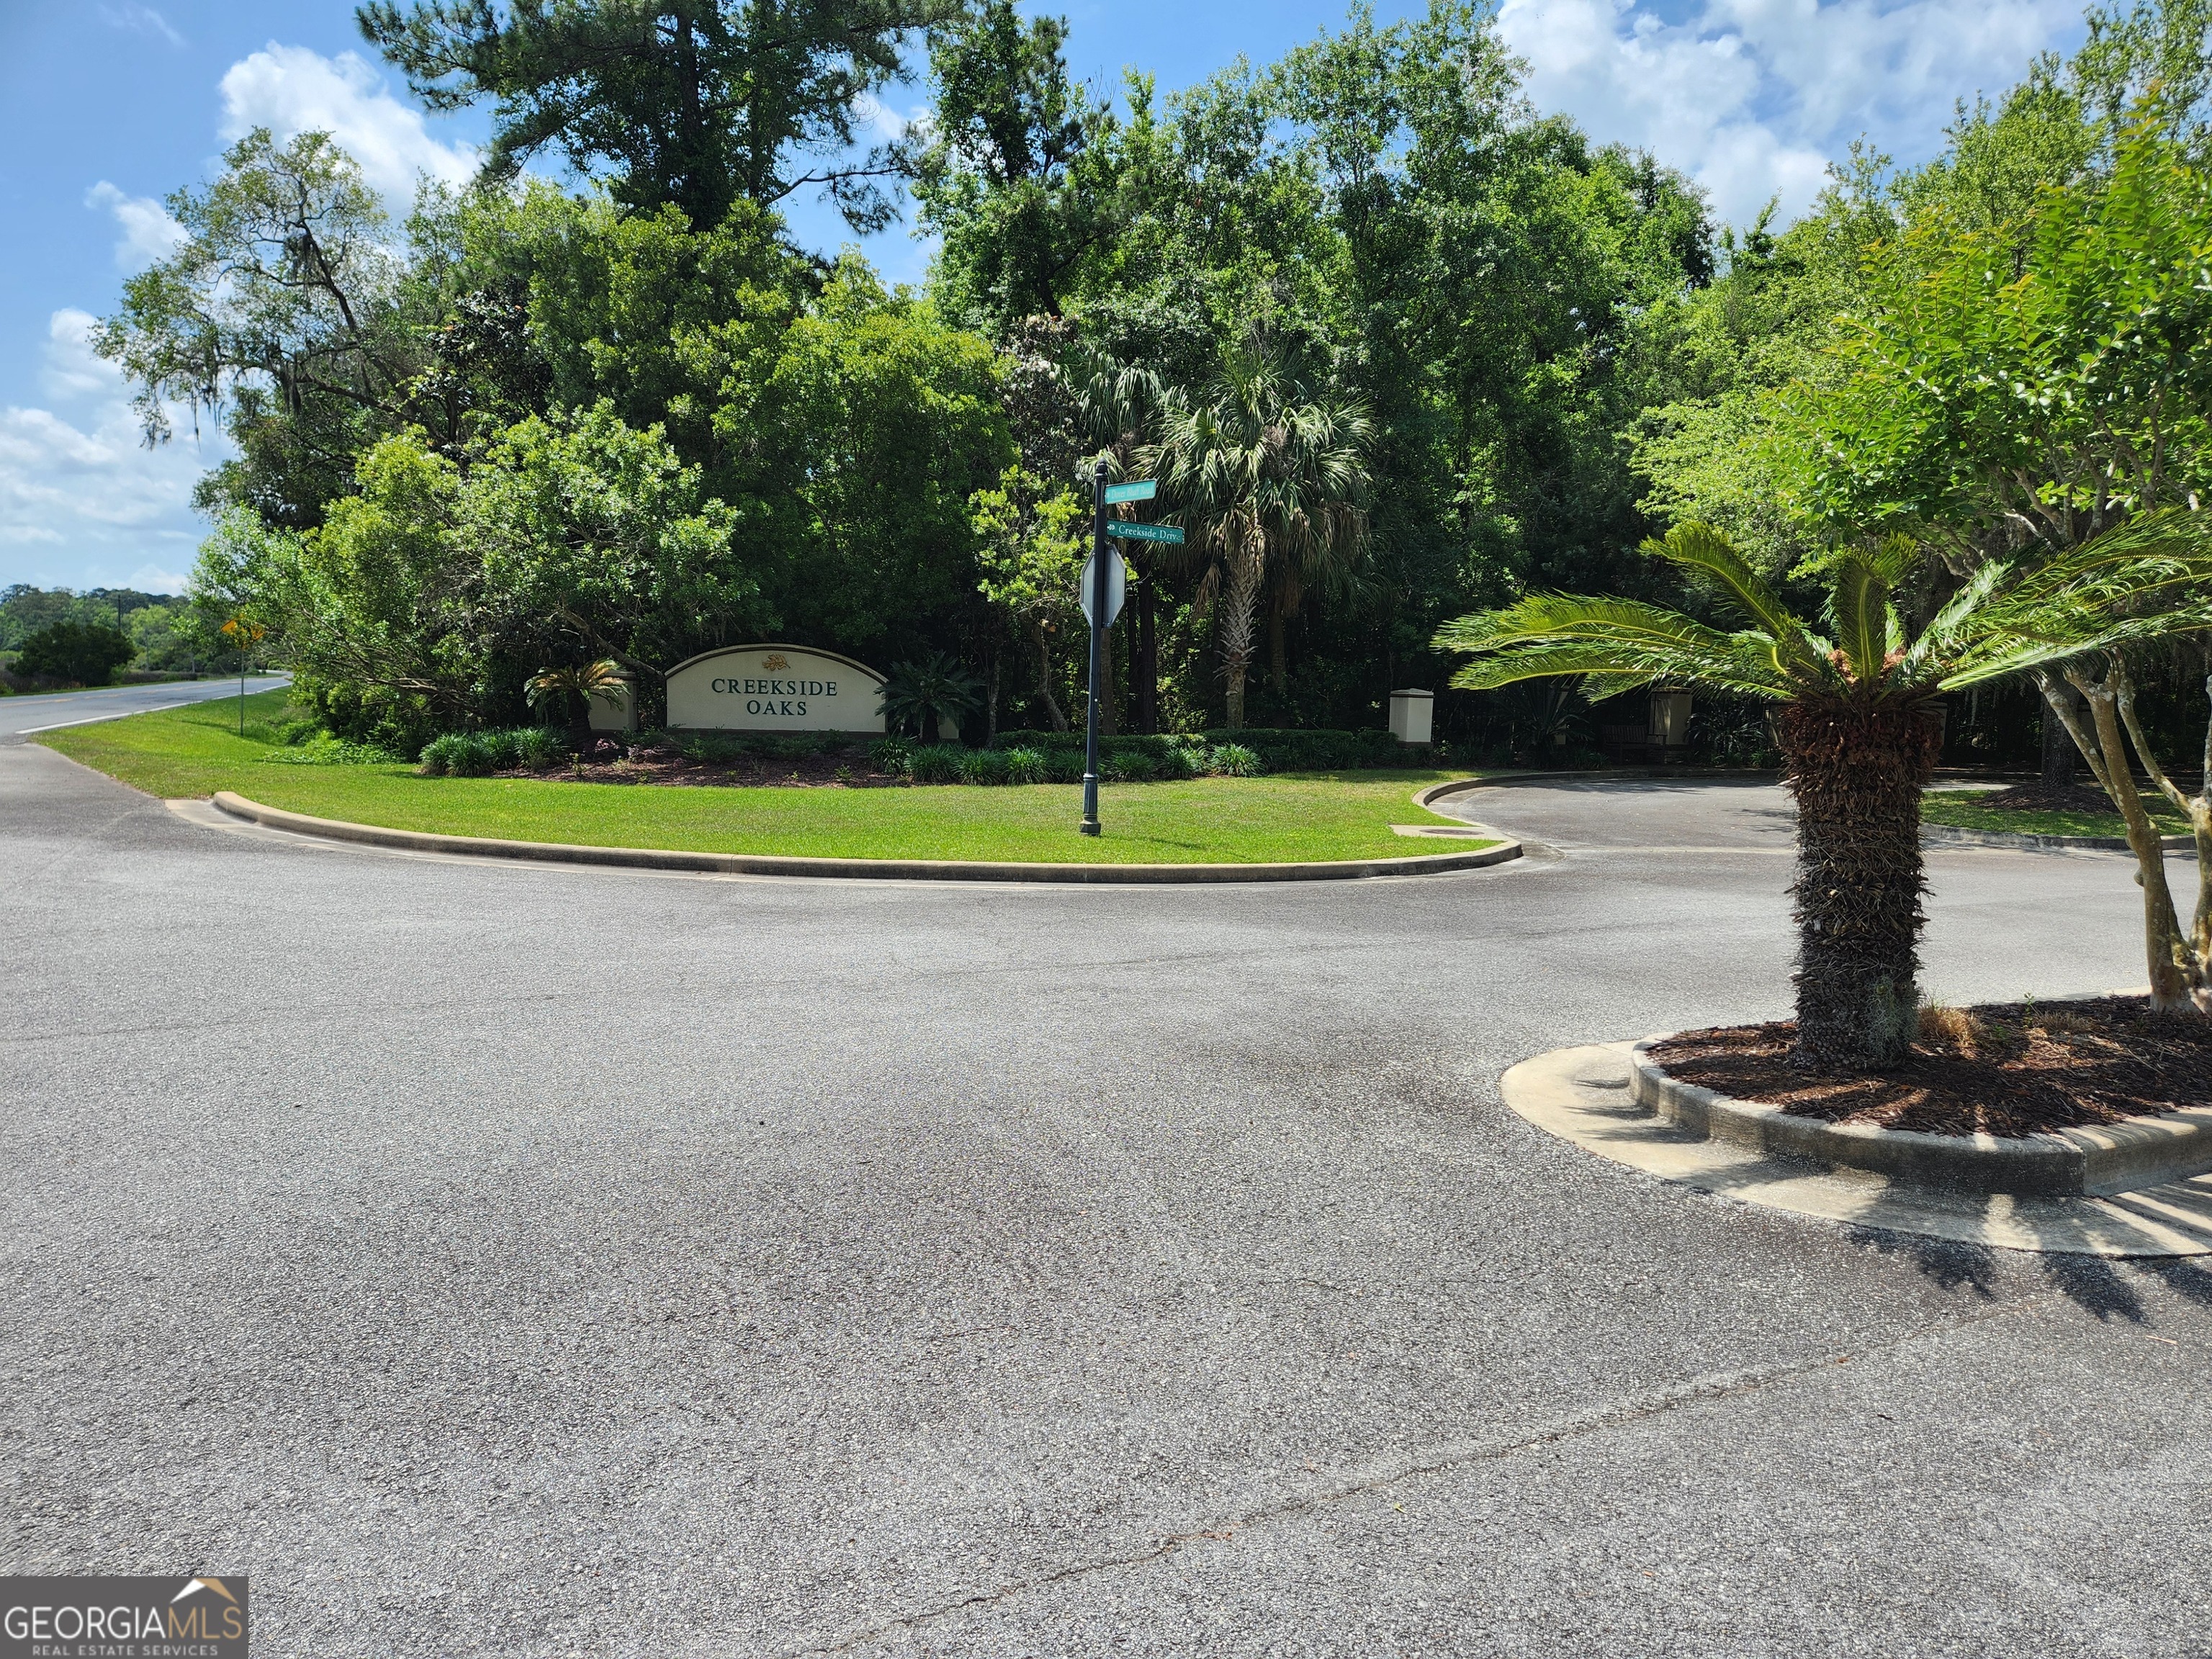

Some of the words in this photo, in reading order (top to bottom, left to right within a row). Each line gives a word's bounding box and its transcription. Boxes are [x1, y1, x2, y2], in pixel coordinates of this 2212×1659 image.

[1141, 484, 1154, 495] Road
[1118, 524, 1156, 538] Creekside
[711, 678, 837, 696] CREEKSIDE
[746, 700, 806, 716] OAKS
